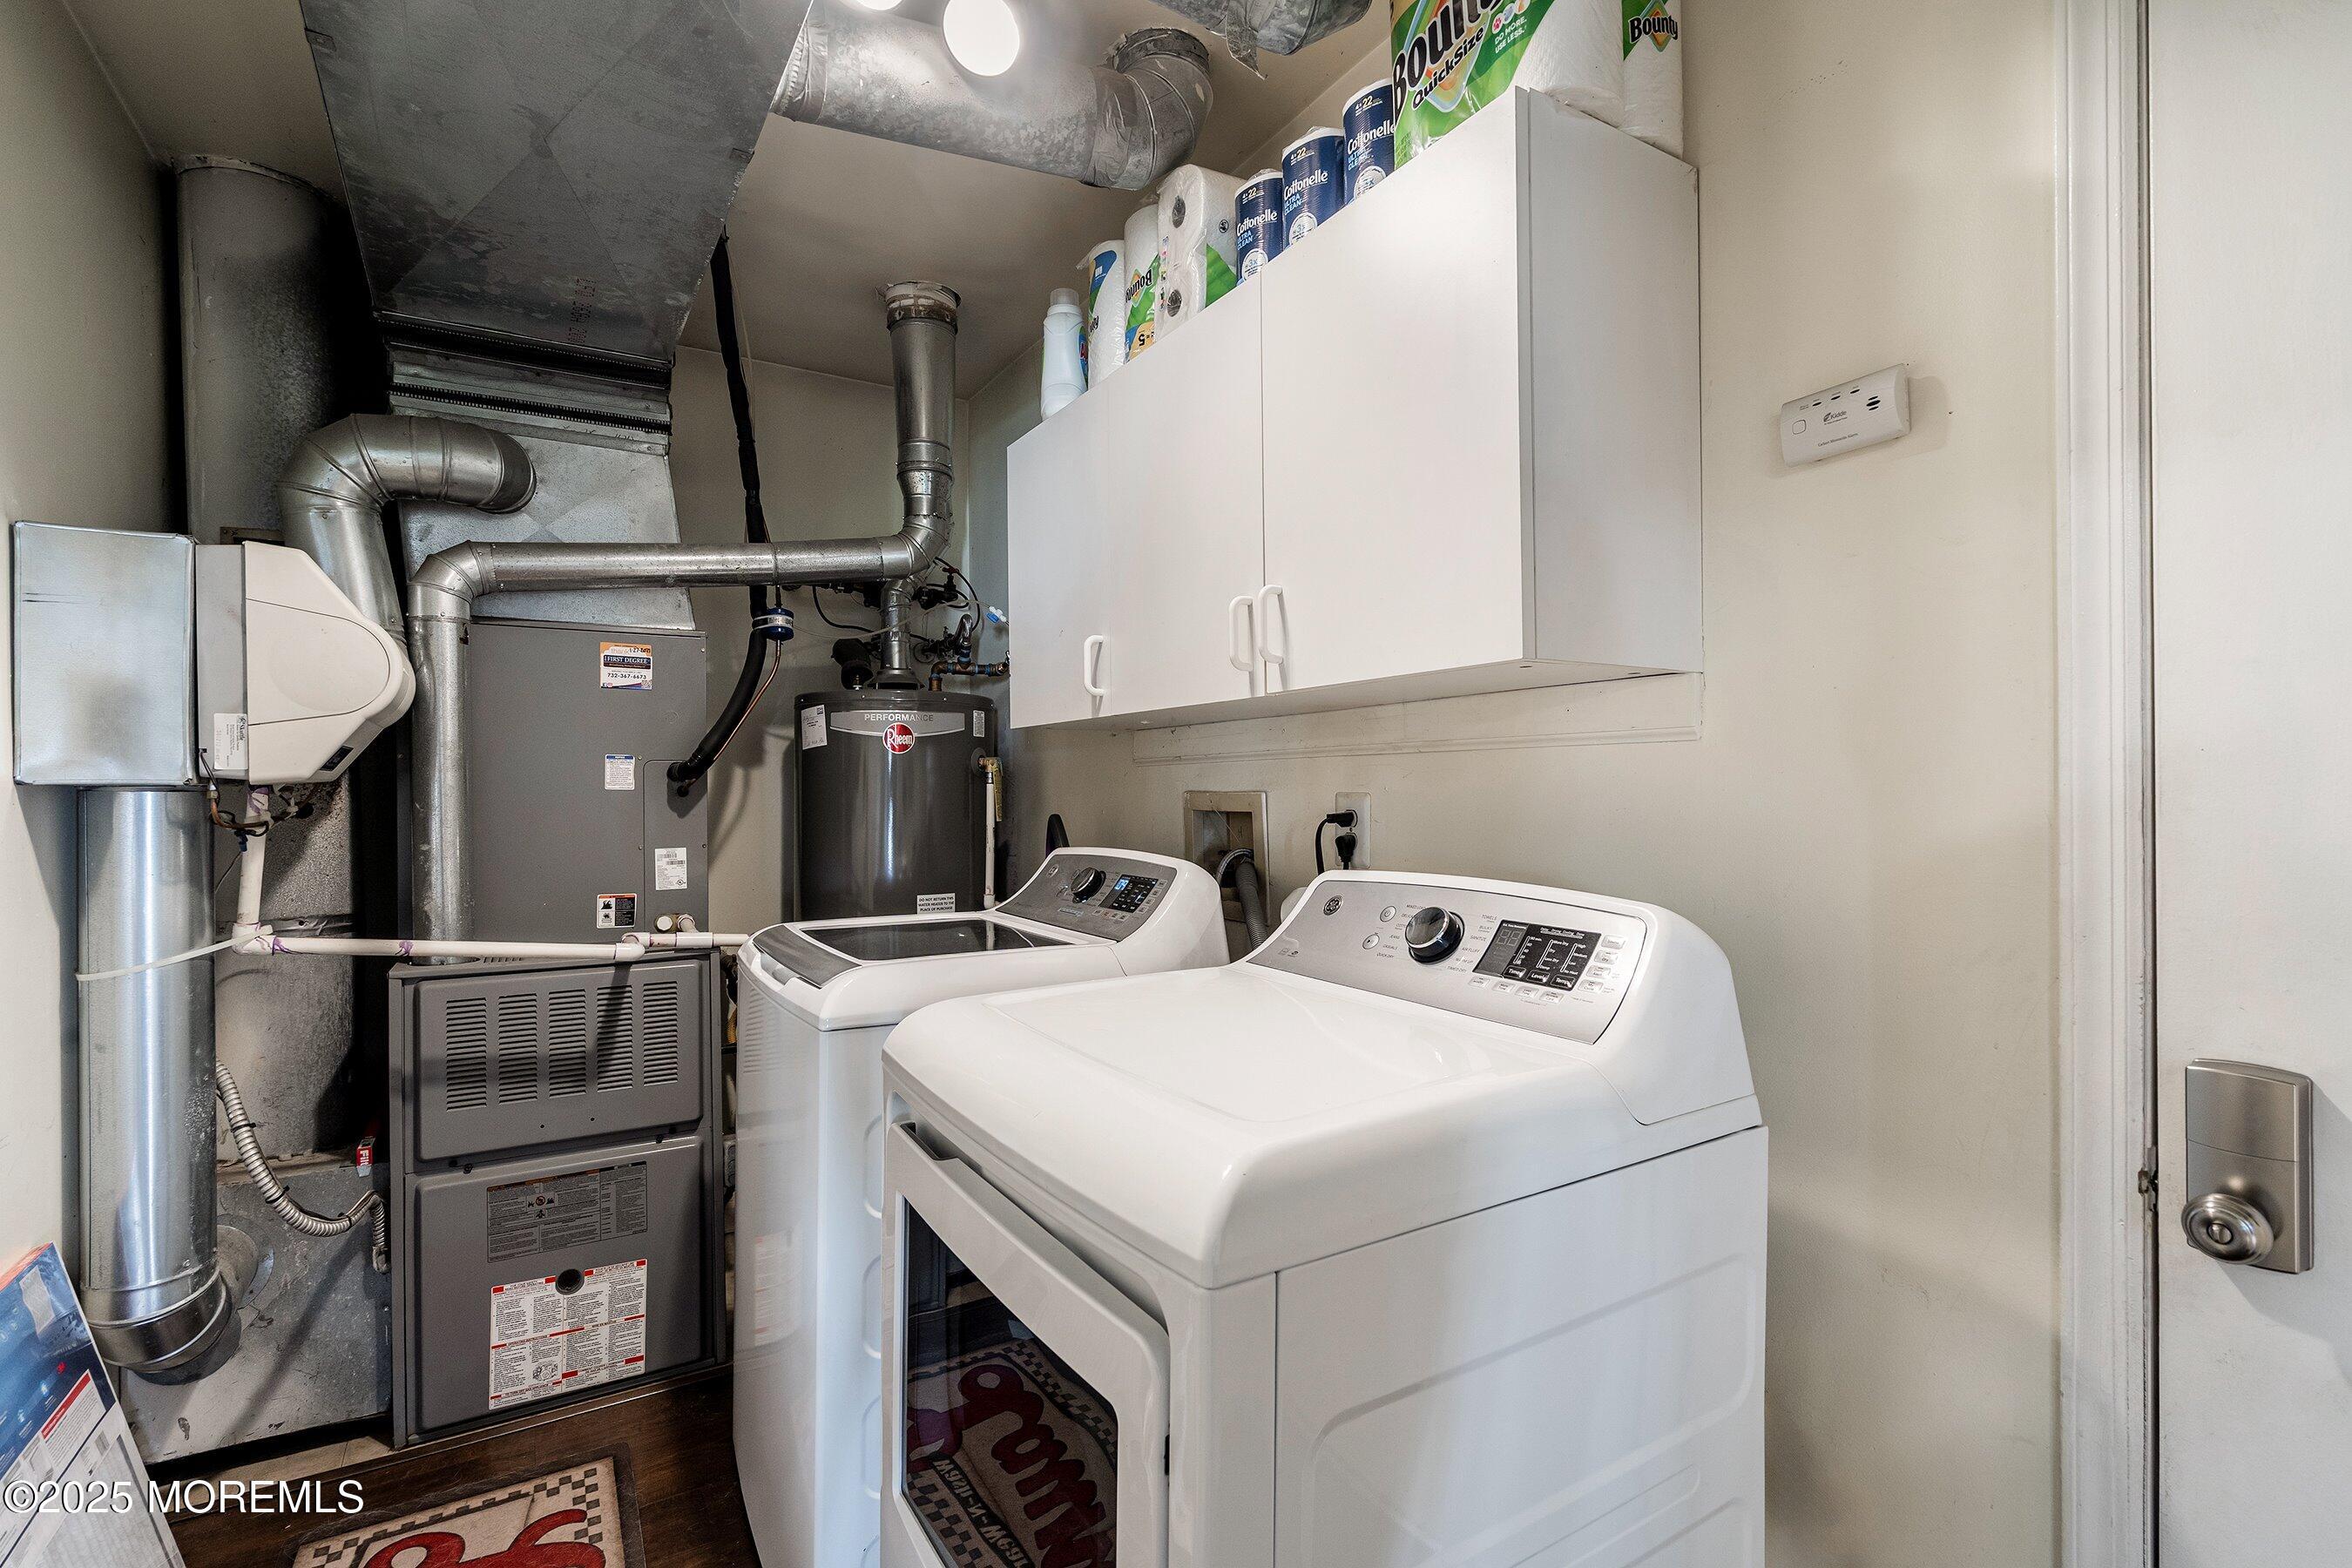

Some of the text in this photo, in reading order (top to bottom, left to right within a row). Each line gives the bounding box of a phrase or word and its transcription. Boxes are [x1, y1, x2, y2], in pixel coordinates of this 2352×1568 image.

[1495, 32, 1504, 44] DO
[1630, 16, 1678, 43] Bounty
[1495, 39, 1507, 53] USE
[1413, 26, 1484, 109] QuickSize
[1362, 96, 1373, 108] 22
[1348, 119, 1394, 155] Cottonelle
[1297, 147, 1307, 159] 22
[1248, 187, 1257, 198] 22
[1284, 169, 1328, 201] Cottonelle
[1237, 209, 1278, 237] Cottonelle
[864, 713, 934, 722] PERFORMANCE
[887, 724, 913, 749] Rheem
